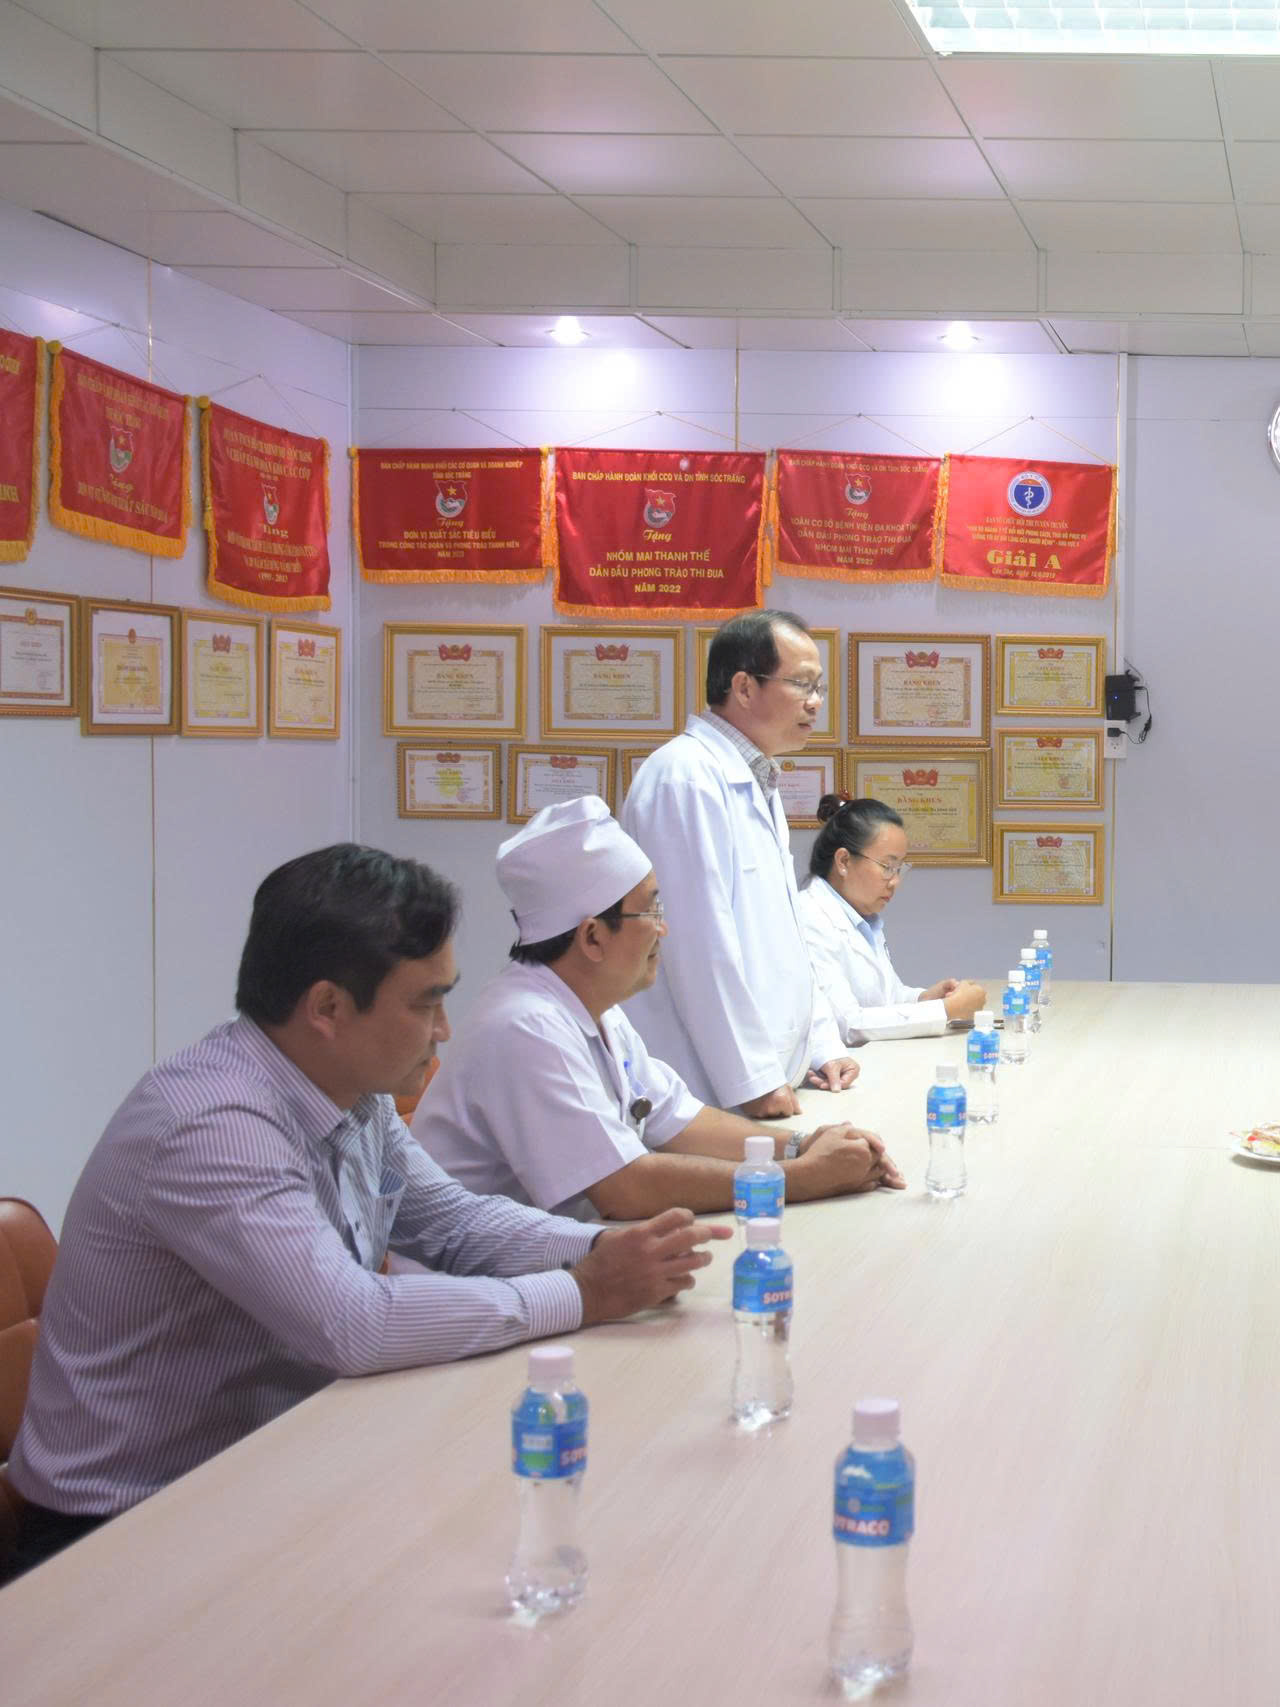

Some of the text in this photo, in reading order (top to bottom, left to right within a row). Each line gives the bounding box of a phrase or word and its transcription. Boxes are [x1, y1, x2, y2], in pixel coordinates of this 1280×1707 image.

[573, 472, 585, 480] BAN
[587, 470, 604, 480] CHẤP
[605, 471, 623, 480] HÀNH
[624, 472, 641, 481] ĐOÀN
[643, 529, 672, 543] Tặng
[606, 548, 711, 561] NHÓM MAI THANH THẾ
[986, 549, 1062, 570] Giải A
[589, 564, 609, 577] DẪN
[631, 568, 662, 578] PHONG
[664, 565, 688, 578] TRÀO
[690, 568, 705, 578] THI
[707, 569, 724, 578] ĐUA
[634, 582, 681, 593] NĂM 2022
